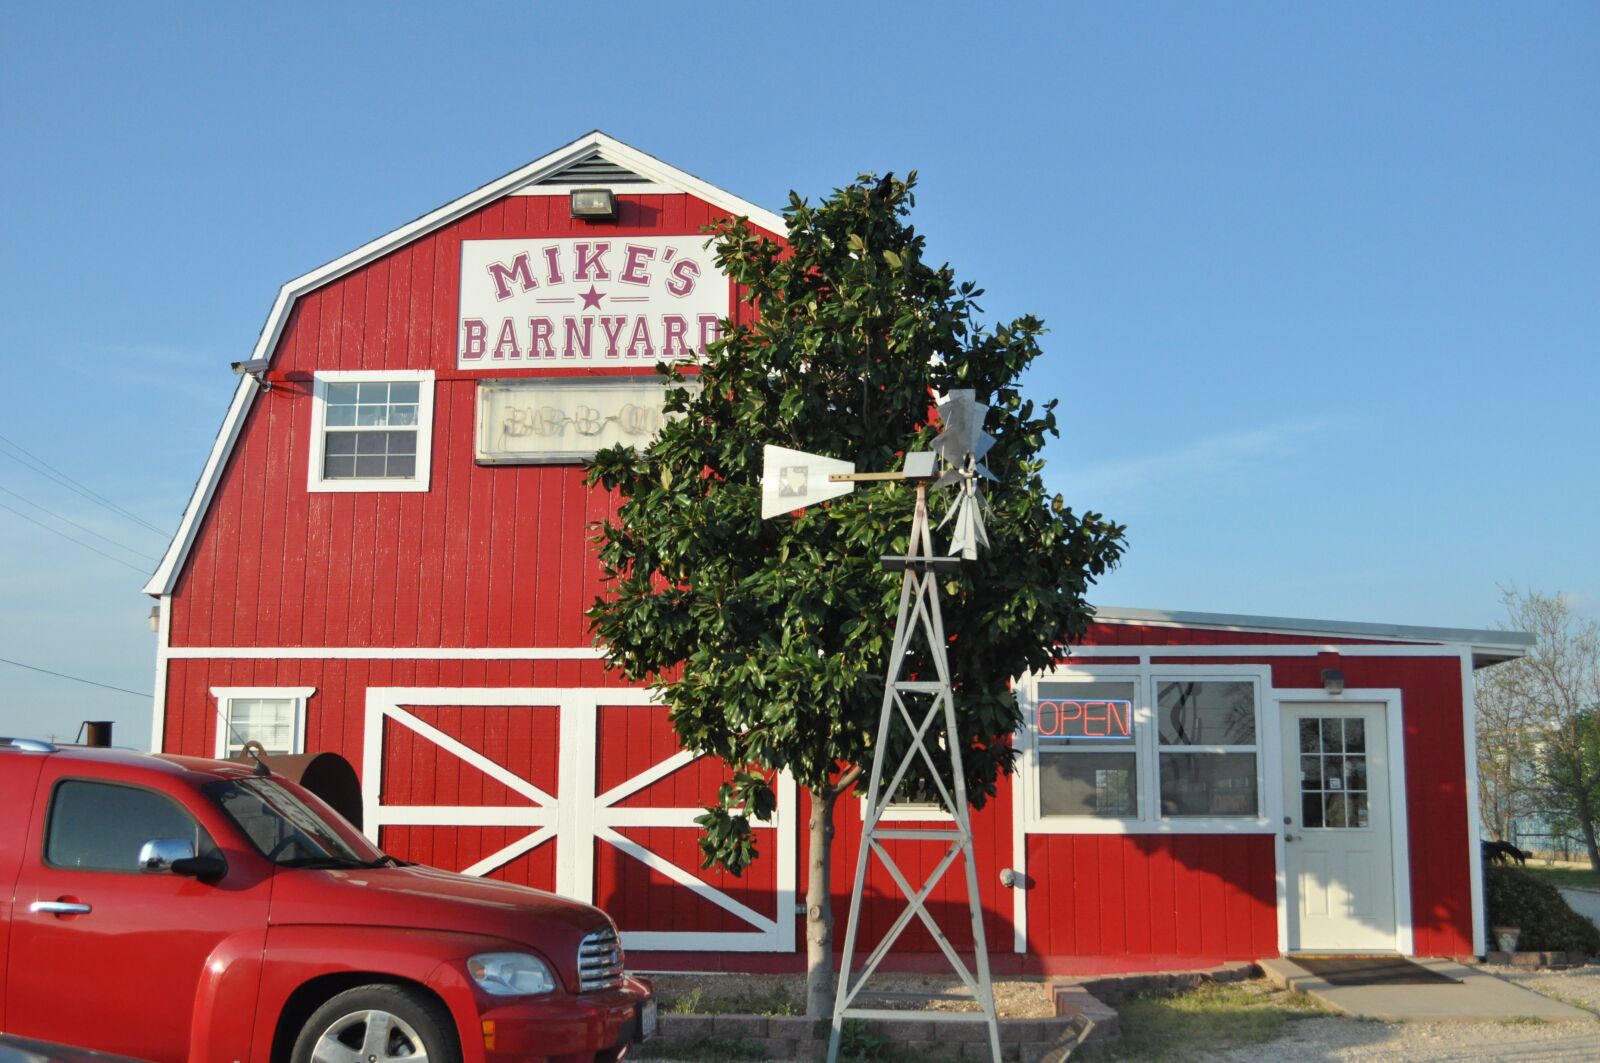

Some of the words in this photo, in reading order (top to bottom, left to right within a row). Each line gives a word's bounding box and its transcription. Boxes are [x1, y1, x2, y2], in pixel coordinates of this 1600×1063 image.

[487, 241, 701, 302] MIKE'S
[462, 313, 722, 361] BARNYARD
[1037, 701, 1129, 736] OPEN
